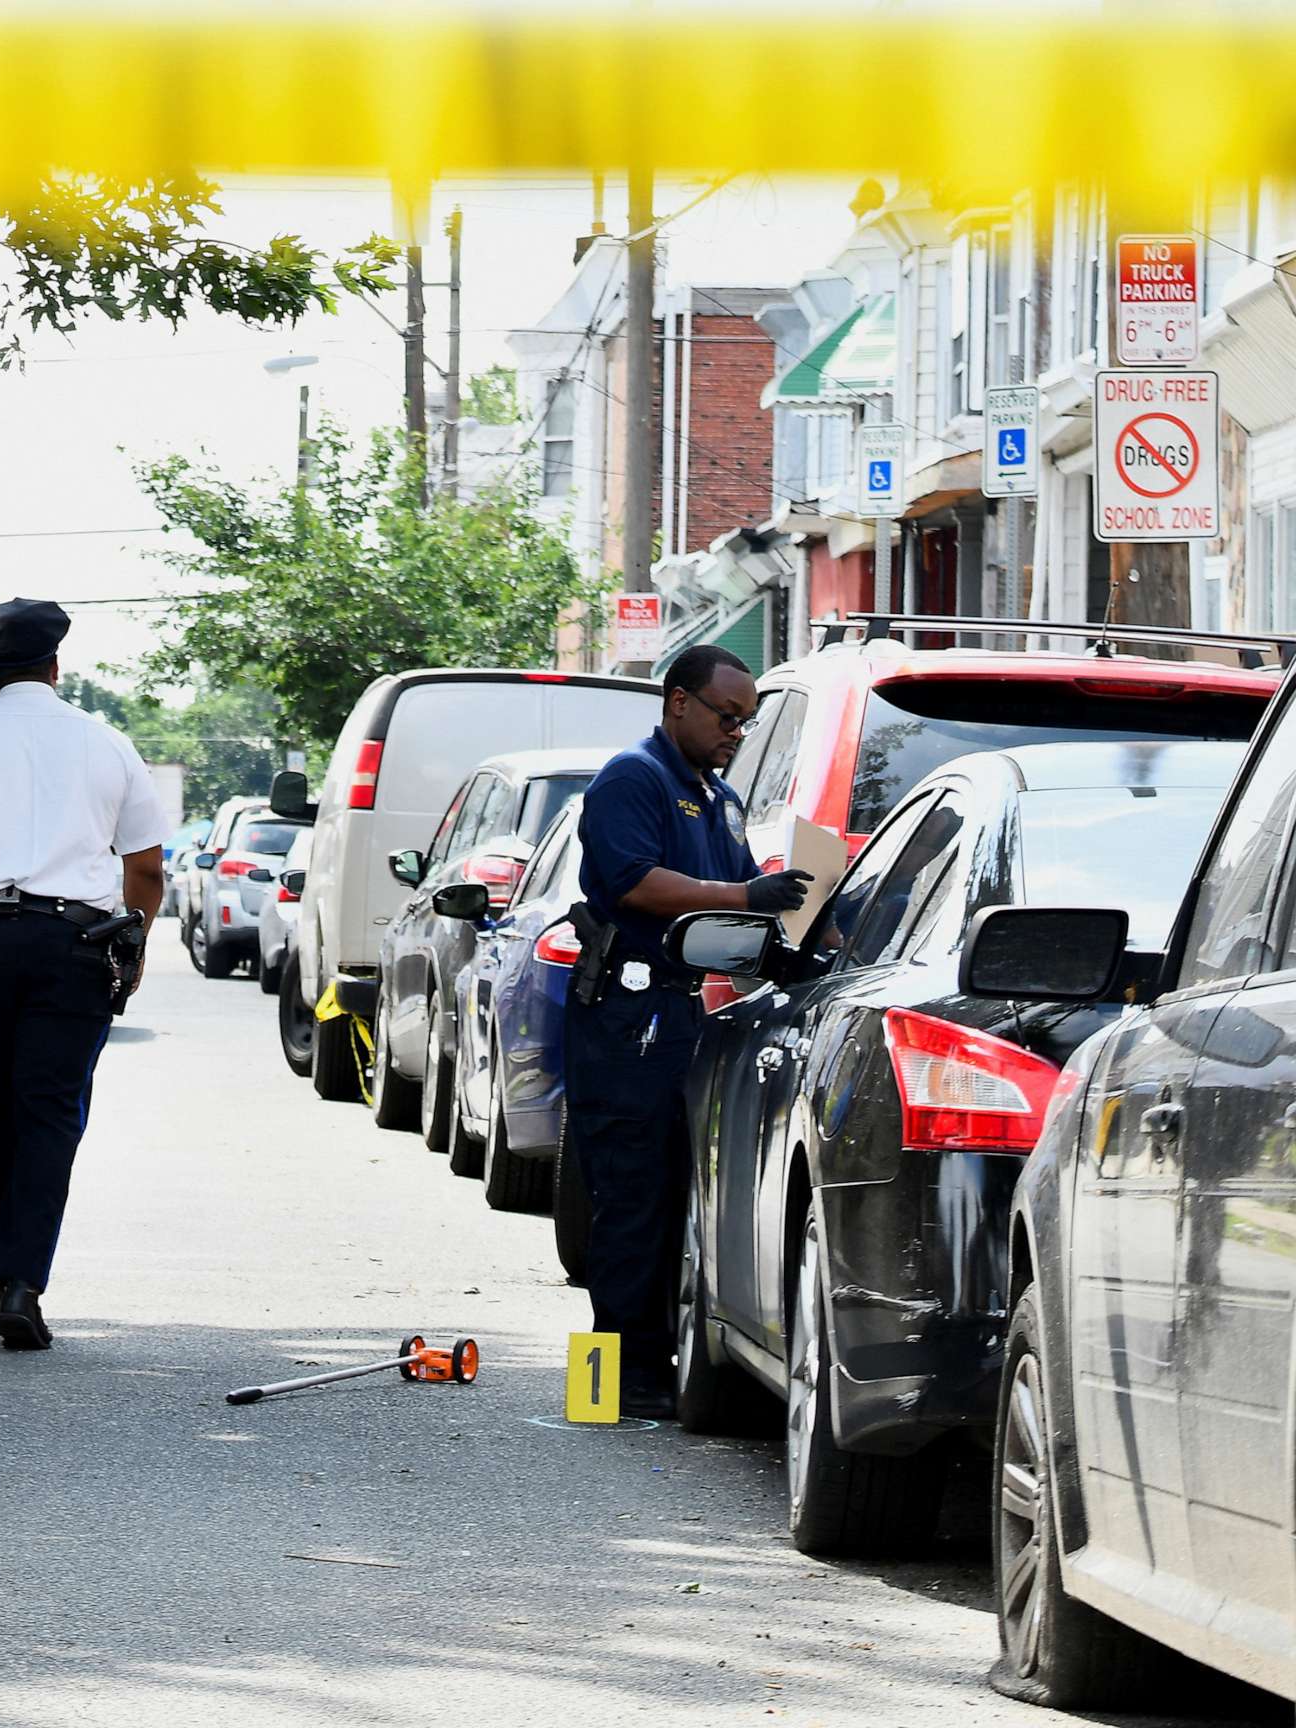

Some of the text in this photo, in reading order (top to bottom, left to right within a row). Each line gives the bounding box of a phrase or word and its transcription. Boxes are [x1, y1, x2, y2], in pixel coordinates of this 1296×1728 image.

[1143, 244, 1171, 261] NO
[1130, 264, 1185, 281] TRUCK
[1122, 283, 1194, 300] PARKING
[988, 392, 1035, 409] RESERVED
[991, 412, 1033, 425] PARKING
[1104, 507, 1213, 530] SCHOOL ZONE
[587, 1347, 601, 1405] 1
